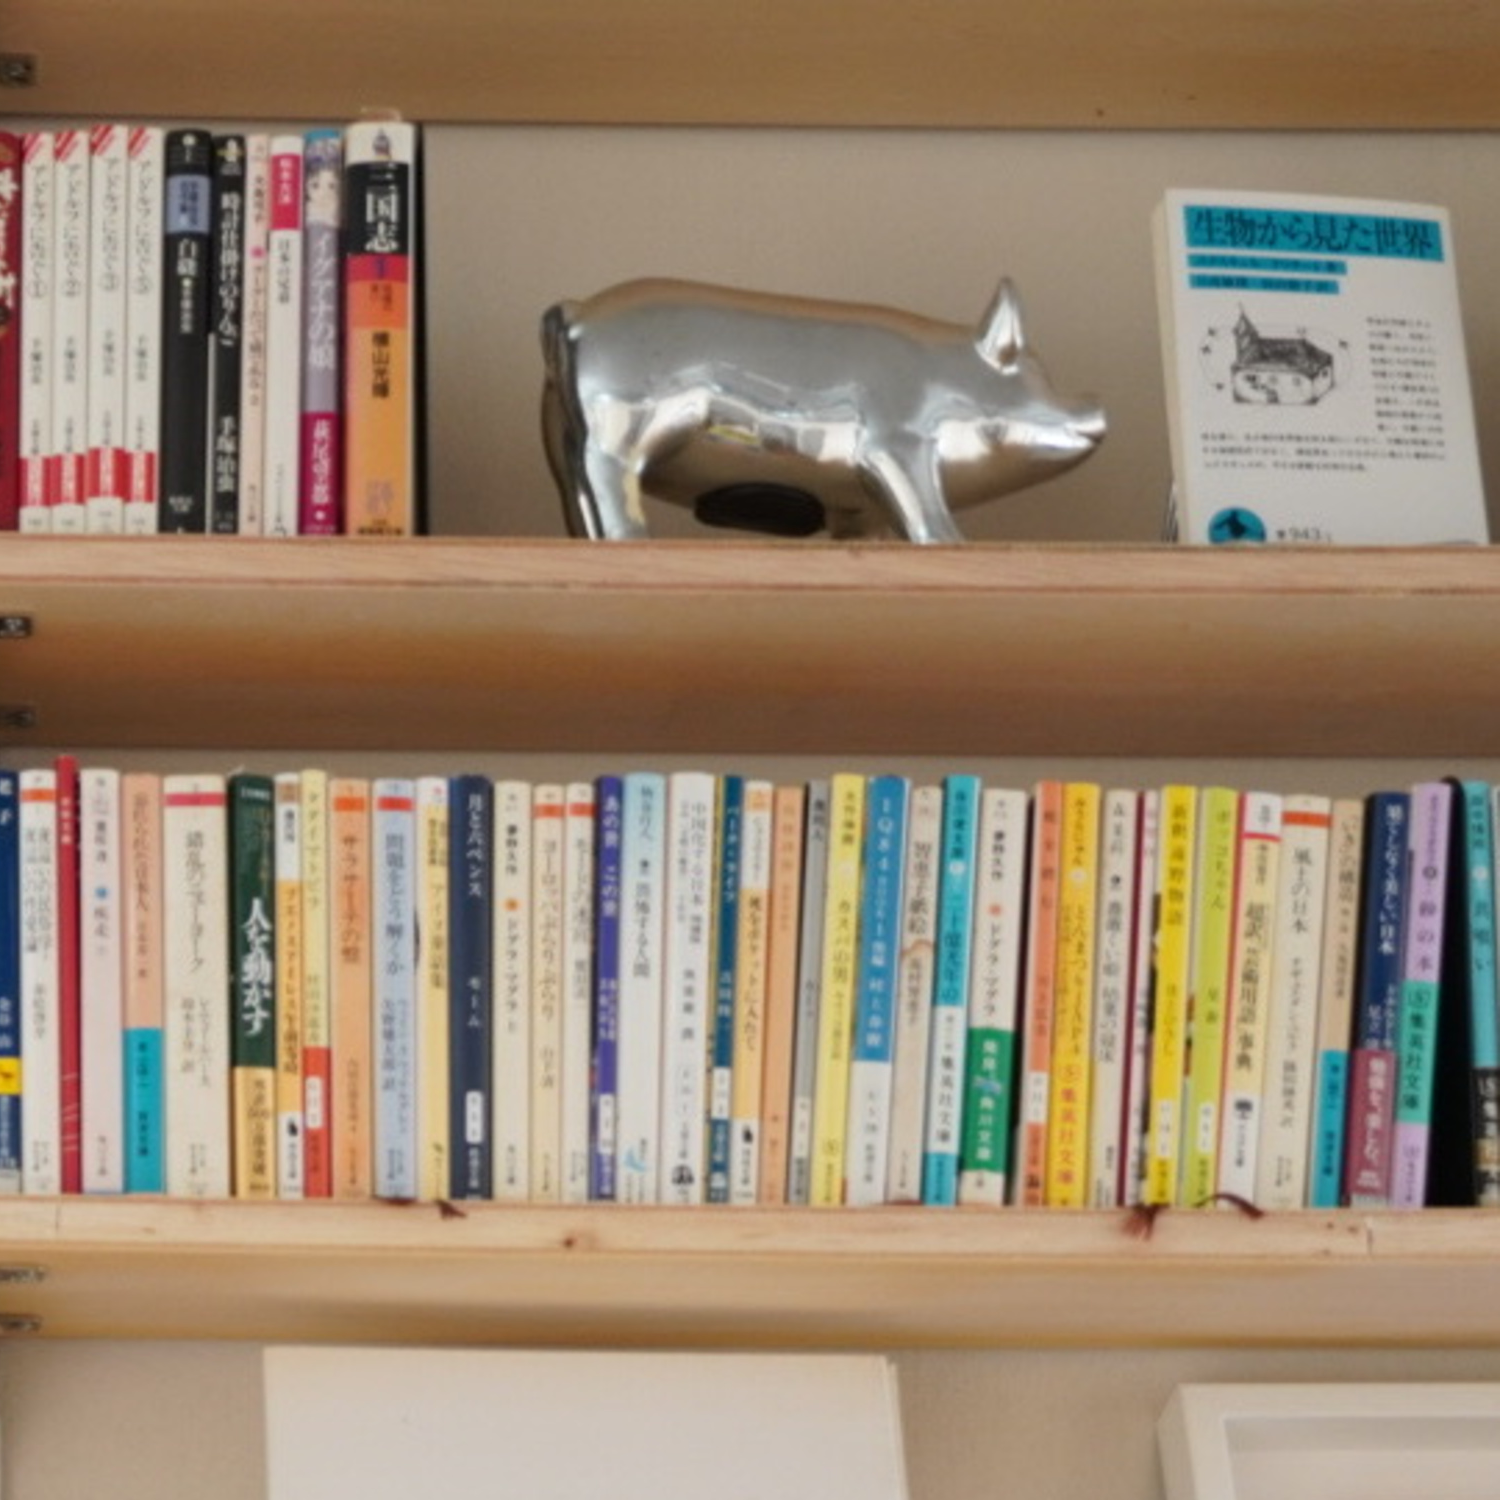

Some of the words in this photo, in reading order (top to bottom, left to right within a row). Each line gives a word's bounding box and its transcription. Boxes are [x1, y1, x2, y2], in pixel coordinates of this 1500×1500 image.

[366, 165, 399, 253] 三国志
[1193, 208, 1432, 253] 生物から見た世界
[310, 234, 335, 369] イグアナの娘
[372, 331, 390, 399] 横山光輝
[216, 416, 238, 492] 手塚治虫
[312, 418, 331, 505] 萩尾望都
[466, 793, 483, 898] 月と六ペンス
[603, 794, 621, 851] あの世
[185, 830, 207, 974] 錯乱のニューヨーク
[341, 834, 361, 967] サラサーテの盤
[602, 865, 620, 918] この世
[907, 842, 932, 935] 智恵子紙絵
[1166, 843, 1185, 927] 遠野物語
[1290, 846, 1311, 935] 風土の日本
[243, 897, 271, 1036] 人を動かす
[834, 899, 852, 983] カスバの男
[866, 976, 885, 1049] 村上春樹
[936, 1055, 956, 1145] 集英社文庫
[1402, 1011, 1424, 1112] 集英社文庫
[976, 1096, 996, 1162] 角川文庫
[1059, 1085, 1077, 1186] 集英社文庫
